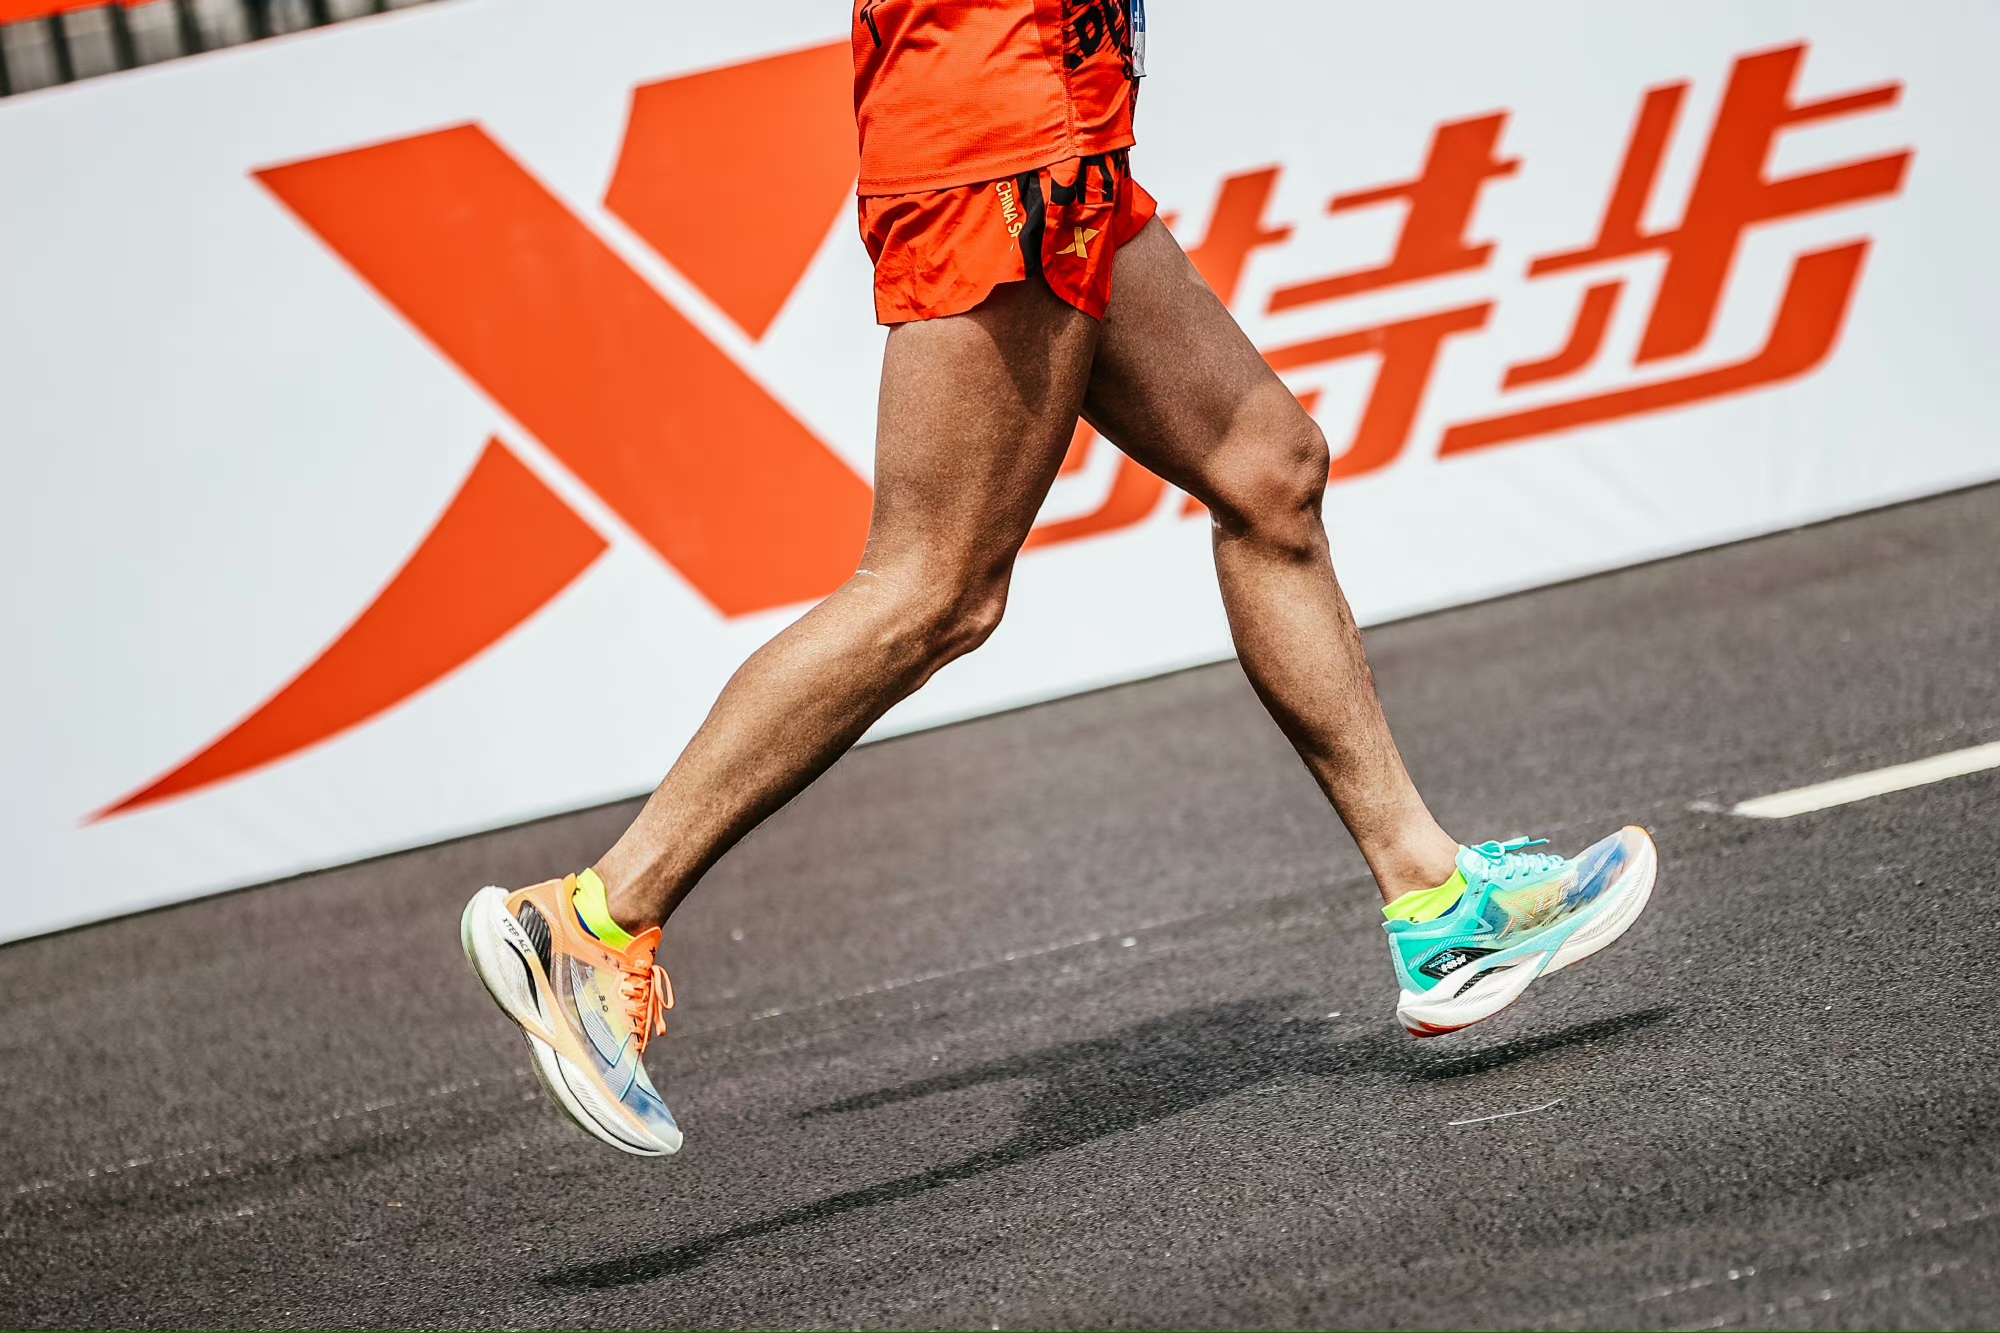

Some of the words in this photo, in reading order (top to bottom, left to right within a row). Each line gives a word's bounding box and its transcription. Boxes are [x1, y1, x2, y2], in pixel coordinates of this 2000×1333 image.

[995, 180, 1019, 225] CHINA
[501, 917, 520, 937] XTEP
[517, 939, 532, 954] ACE
